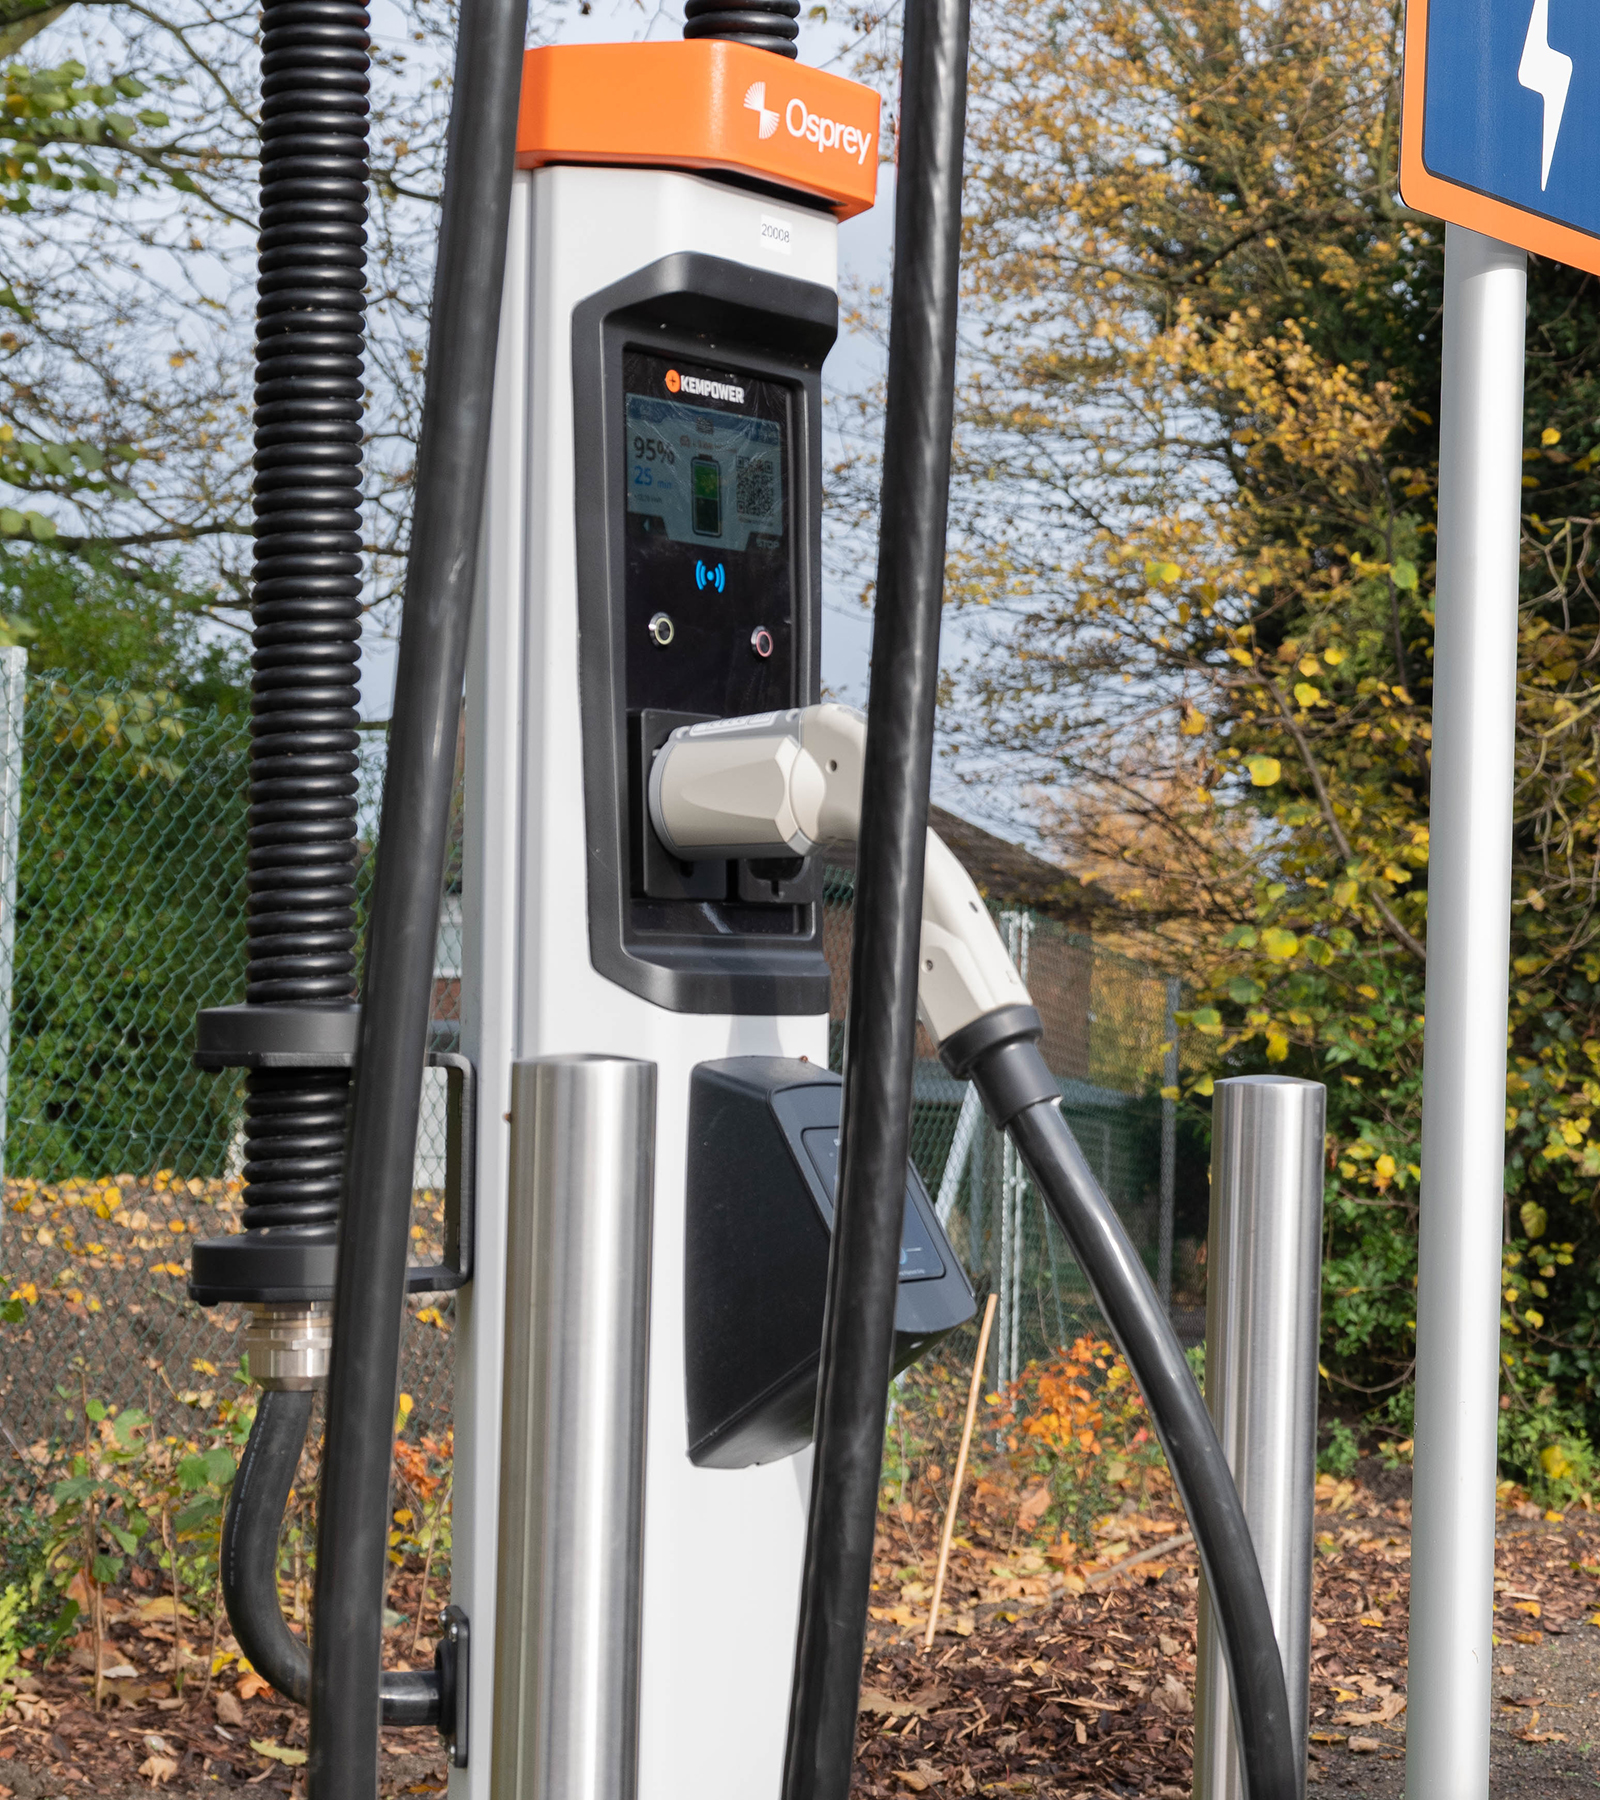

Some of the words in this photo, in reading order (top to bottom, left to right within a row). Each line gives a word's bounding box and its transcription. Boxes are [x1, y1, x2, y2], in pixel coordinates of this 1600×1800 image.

[785, 98, 872, 165] Osprey
[762, 223, 790, 243] 20008
[680, 375, 745, 404] KEMPOWER
[634, 436, 675, 464] 95%
[634, 465, 653, 486] 25
